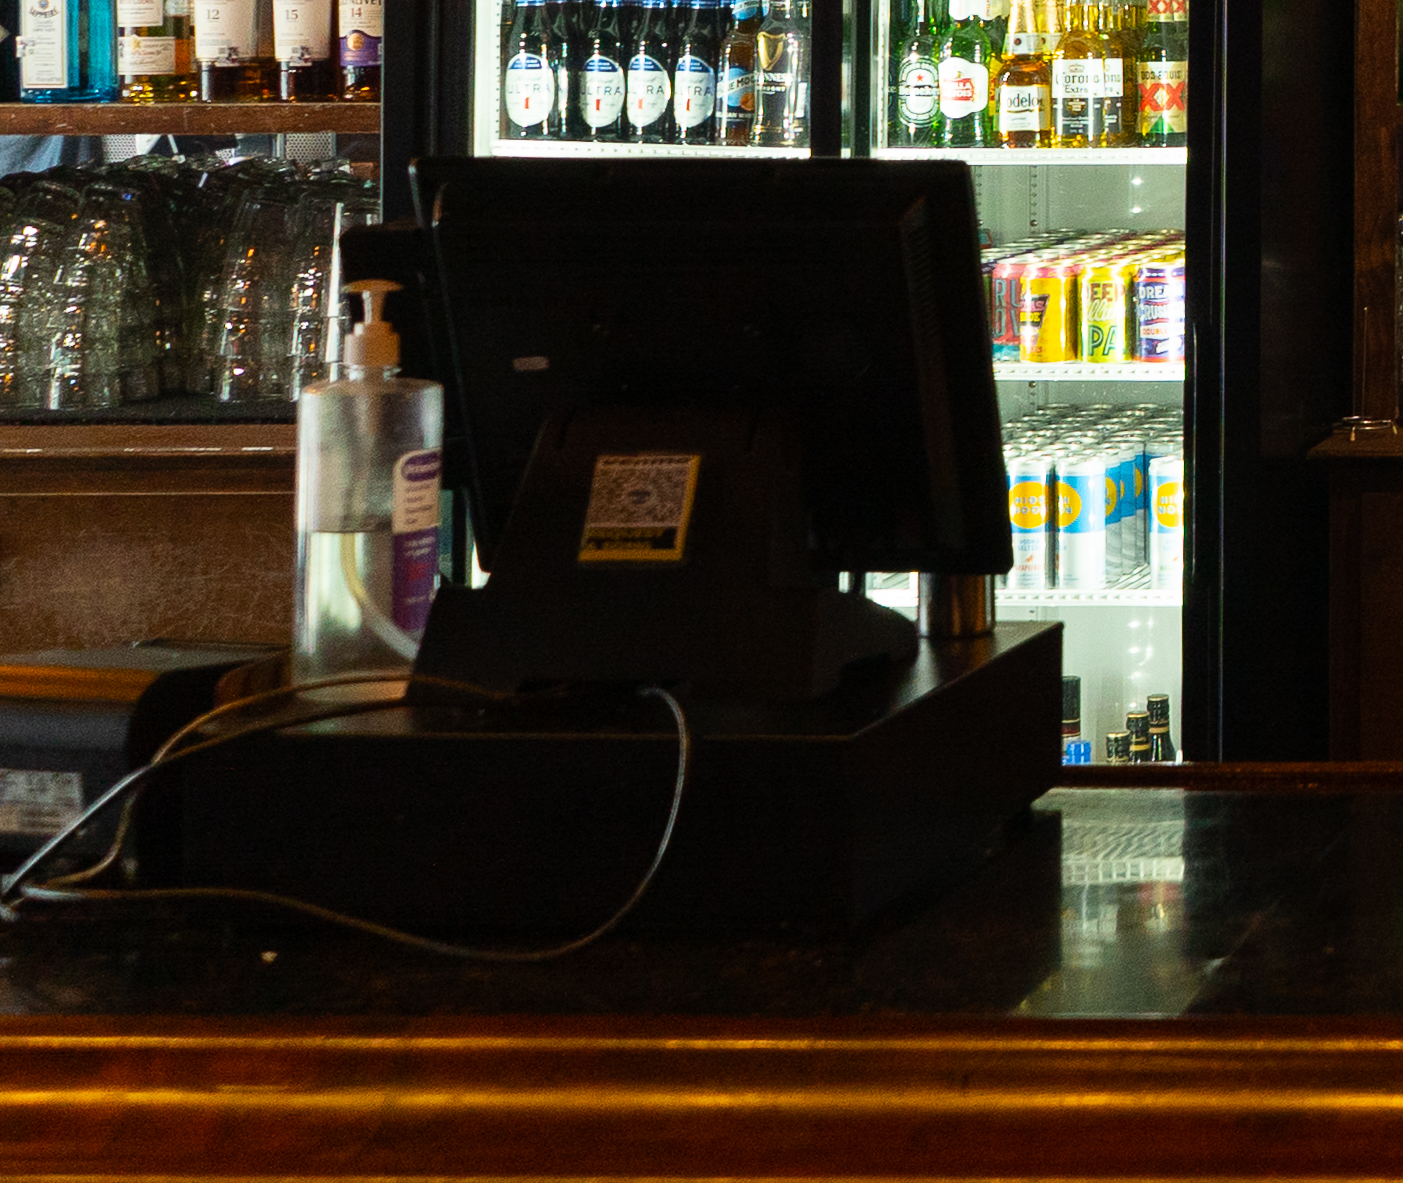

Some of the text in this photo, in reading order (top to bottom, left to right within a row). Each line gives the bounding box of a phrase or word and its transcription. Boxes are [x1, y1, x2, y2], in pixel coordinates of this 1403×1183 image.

[206, 9, 220, 21] 12
[285, 9, 299, 21] 15
[351, 7, 363, 18] 14
[1139, 81, 1187, 112] XX
